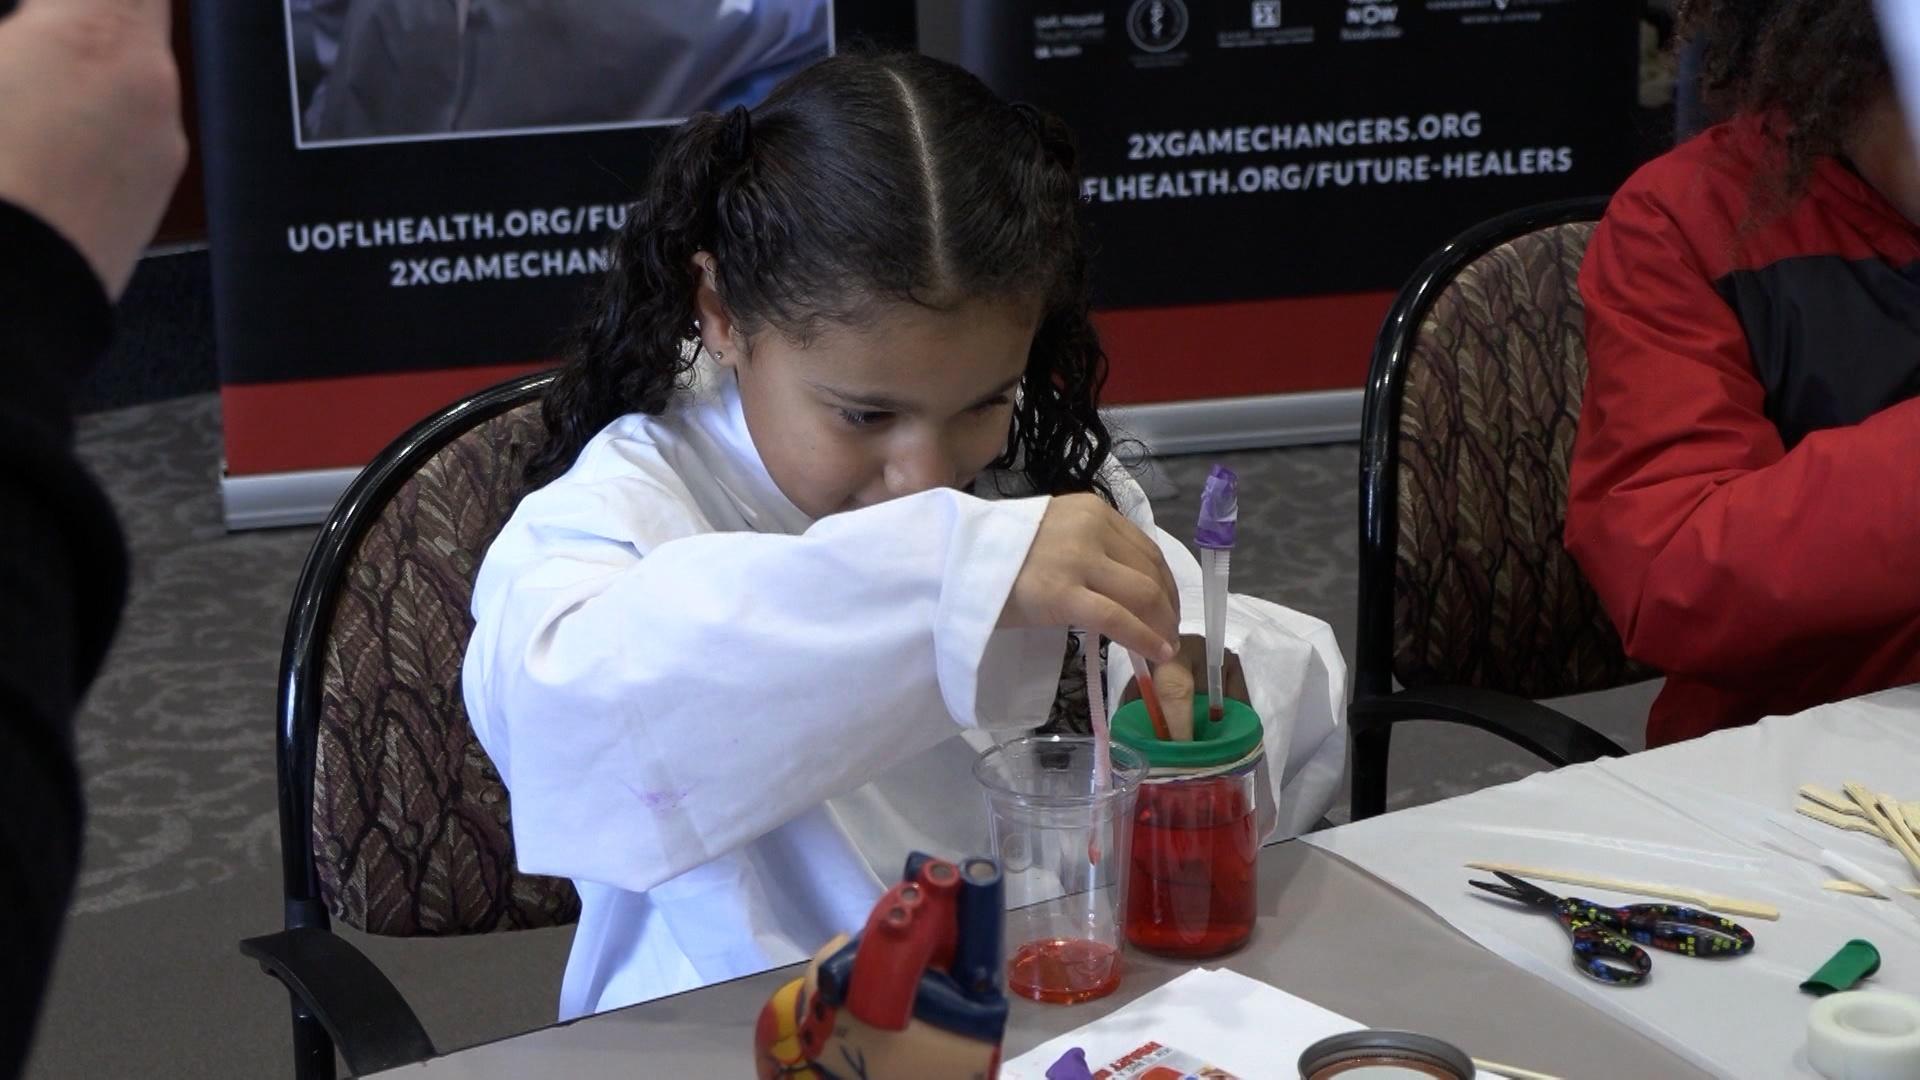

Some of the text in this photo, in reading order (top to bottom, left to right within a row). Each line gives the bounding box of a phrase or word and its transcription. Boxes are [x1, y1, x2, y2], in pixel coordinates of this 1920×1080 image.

[1127, 111, 1482, 161] 2XGAMECHANGERS.ORG
[1080, 146, 1573, 203] FLHEALTH.ORG/FUTURE-HEALERS
[286, 203, 632, 253] UOFLHEALTH.ORG/FU
[389, 247, 611, 288] 2XGAMECHAN
